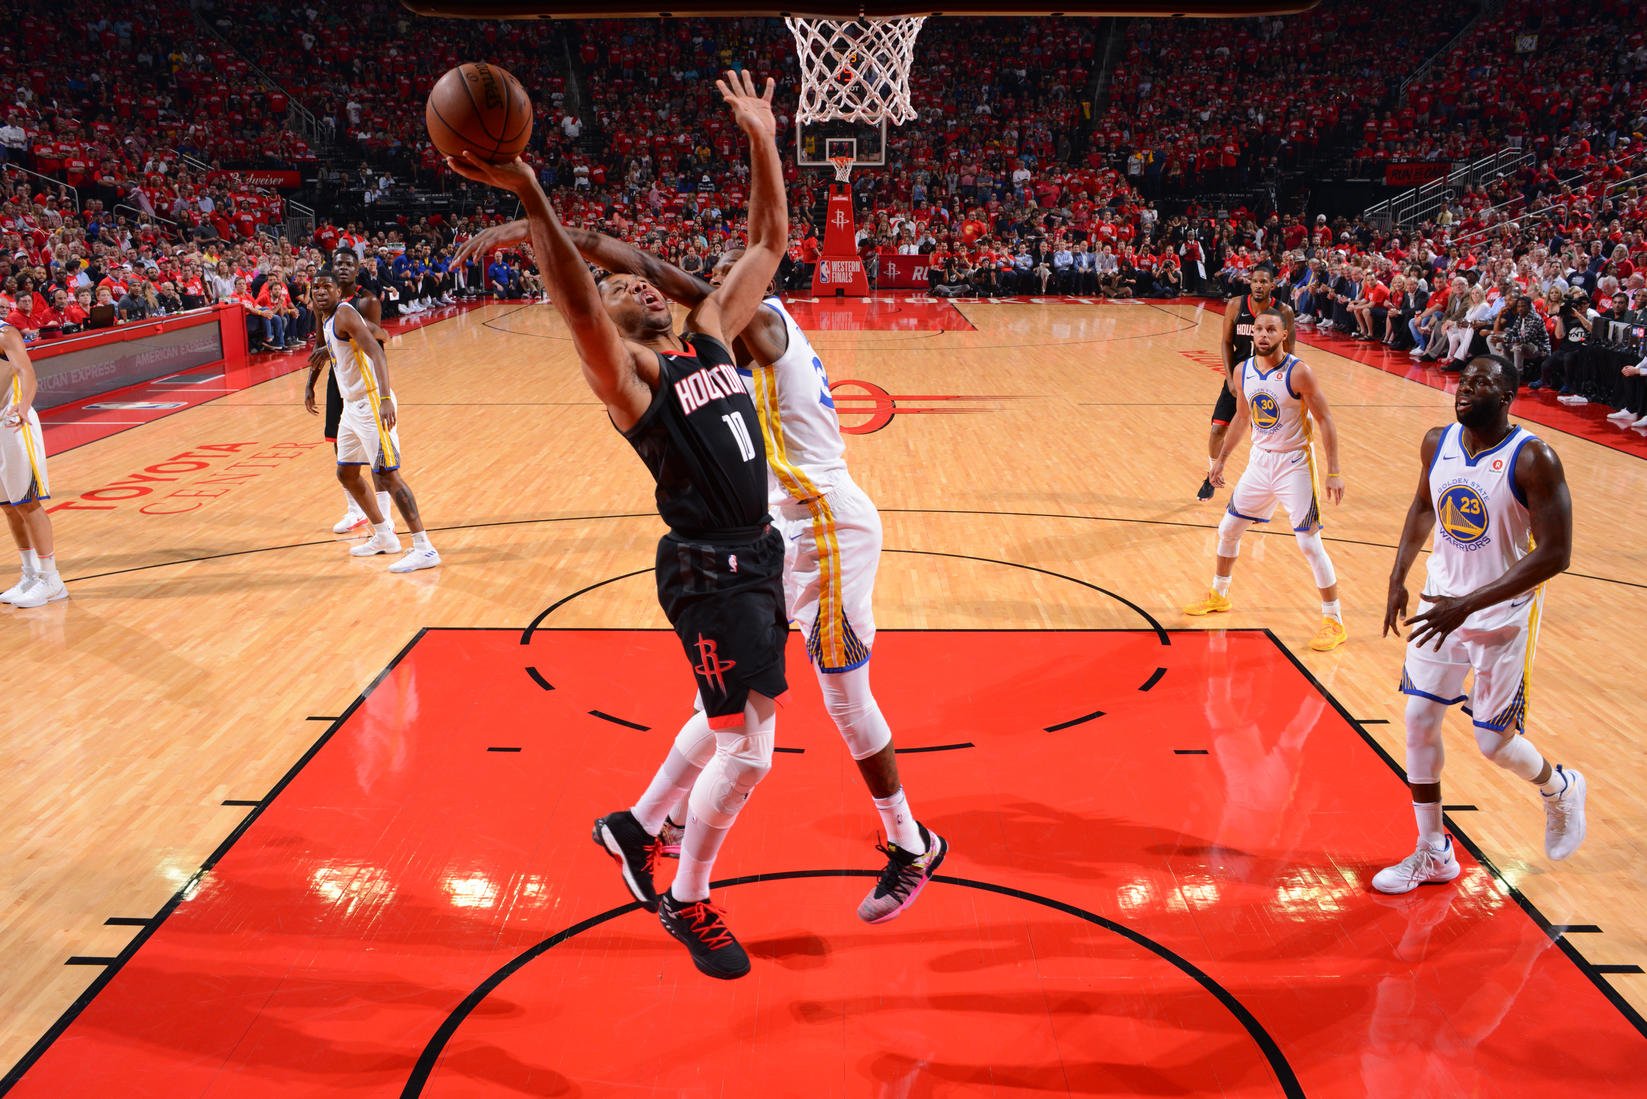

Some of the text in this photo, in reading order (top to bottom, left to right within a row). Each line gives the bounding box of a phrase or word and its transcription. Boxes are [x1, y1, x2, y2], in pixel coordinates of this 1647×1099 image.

[230, 172, 284, 185] Bdweiser
[831, 261, 861, 272] WESTERN
[831, 272, 853, 283] FINALS
[1236, 324, 1255, 336] HOUS
[136, 344, 178, 367] AMERICAN
[38, 360, 116, 391] RICAN EXPRESS
[674, 363, 747, 416] HOUTON
[1261, 399, 1274, 410] 30
[722, 411, 756, 463] 10
[46, 441, 259, 515] TOYOTA
[139, 441, 325, 516] CENTER
[1437, 477, 1490, 502] GOLDEN STATE
[1460, 497, 1480, 515] 23
[1439, 527, 1492, 553] WARRIORS
